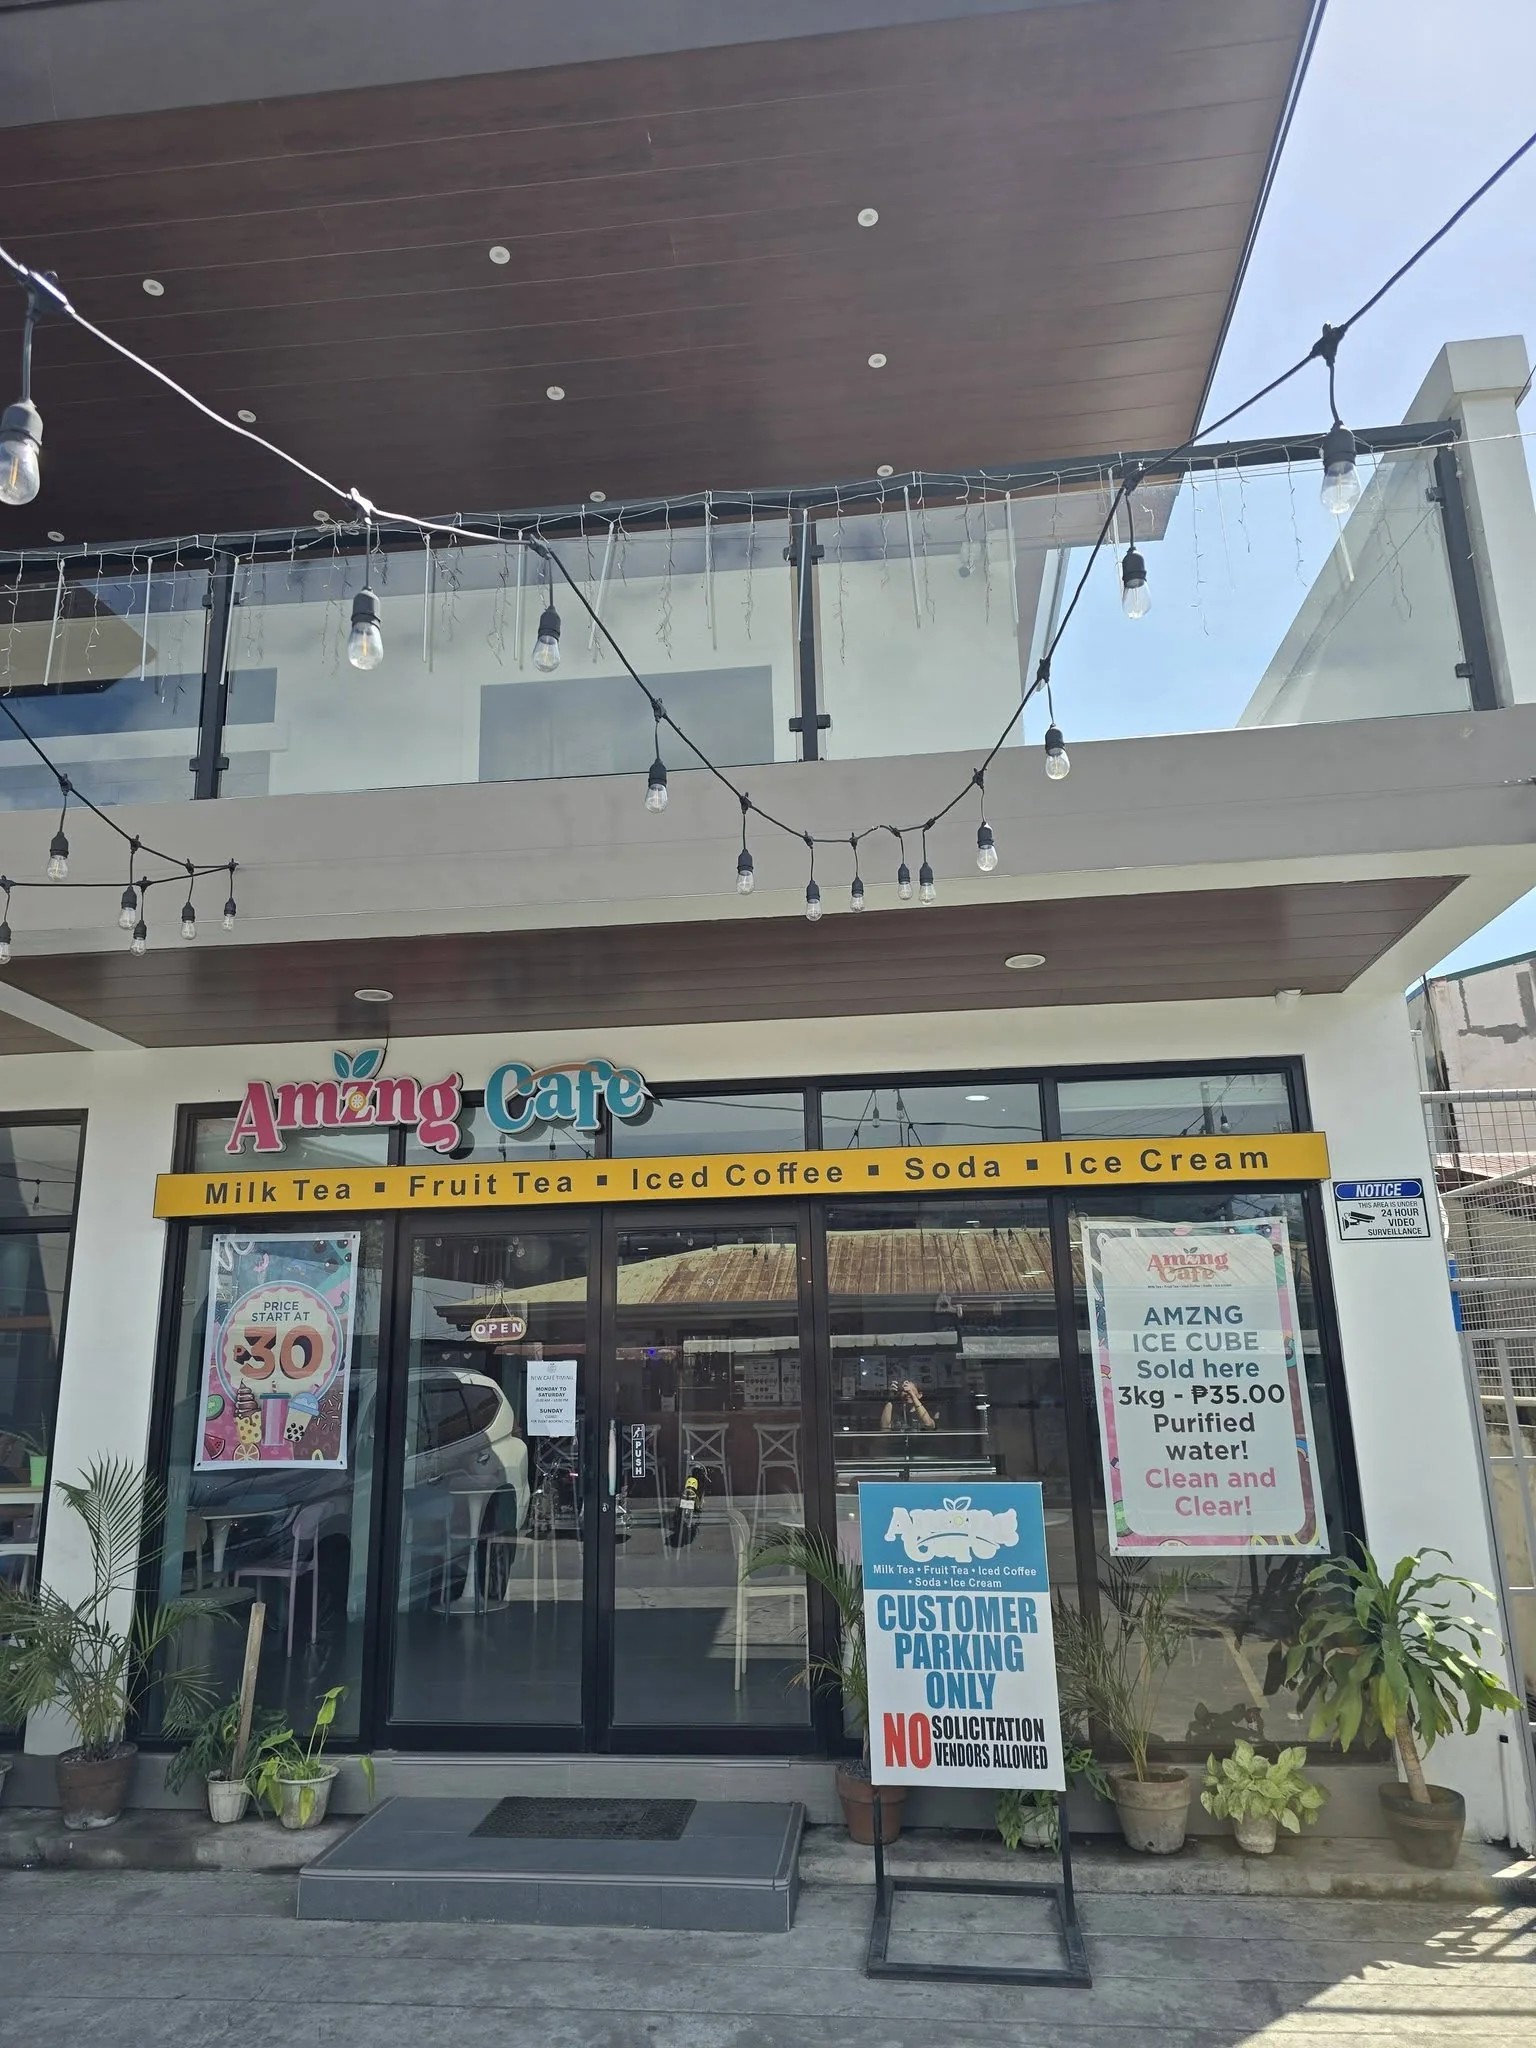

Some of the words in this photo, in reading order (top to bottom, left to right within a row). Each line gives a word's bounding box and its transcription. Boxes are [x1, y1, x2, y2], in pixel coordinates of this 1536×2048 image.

[226, 1072, 462, 1152] Amzng
[485, 1059, 646, 1135] Cafe
[205, 1181, 277, 1204] Milk
[293, 1179, 351, 1200] Tea
[409, 1170, 496, 1197] Fruit
[513, 1171, 572, 1194] Tea
[632, 1165, 709, 1190] Iced
[726, 1162, 843, 1187] Coffee
[904, 1156, 1001, 1180] Soda
[1065, 1152, 1122, 1175] Ice
[1140, 1149, 1269, 1172] Cream
[1356, 1183, 1402, 1197] NOTICE
[1381, 1209, 1393, 1217] 24
[1394, 1208, 1419, 1217] HOUR
[1388, 1218, 1415, 1227] VIDEO
[1367, 1227, 1422, 1236] SURVEILLANCE
[263, 1301, 299, 1311] PRICE
[1144, 1306, 1243, 1325] AMZNG
[251, 1312, 290, 1322] START
[294, 1311, 310, 1321] AT
[475, 1323, 522, 1335] OPEN
[1133, 1333, 1177, 1352] ICE
[1186, 1332, 1259, 1351] CUBE
[1137, 1359, 1194, 1379] Sold
[1203, 1359, 1259, 1378] here
[1118, 1386, 1165, 1409] 3kg
[1153, 1412, 1255, 1433] Purified
[1165, 1440, 1249, 1460] water!
[1145, 1468, 1218, 1489] Clean
[1227, 1467, 1276, 1488] and
[1175, 1496, 1252, 1517] Clear!
[873, 1565, 894, 1575] Milk
[897, 1565, 914, 1574] Tea
[924, 1566, 948, 1575] Fruit
[951, 1566, 969, 1575] Tea
[979, 1566, 1000, 1576] Iced
[1003, 1567, 1037, 1576] Coffee
[915, 1578, 941, 1587] Soda
[951, 1578, 966, 1587] Ice
[968, 1579, 1002, 1588] Cream
[877, 1594, 1038, 1633] CUSTOMER
[895, 1633, 1025, 1672] PARKING
[926, 1671, 996, 1710] ONLY
[883, 1712, 932, 1769] NO
[932, 1715, 1045, 1742] SOLICITATION
[934, 1742, 990, 1767] VENDORS
[993, 1744, 1048, 1770] ALLOWED
